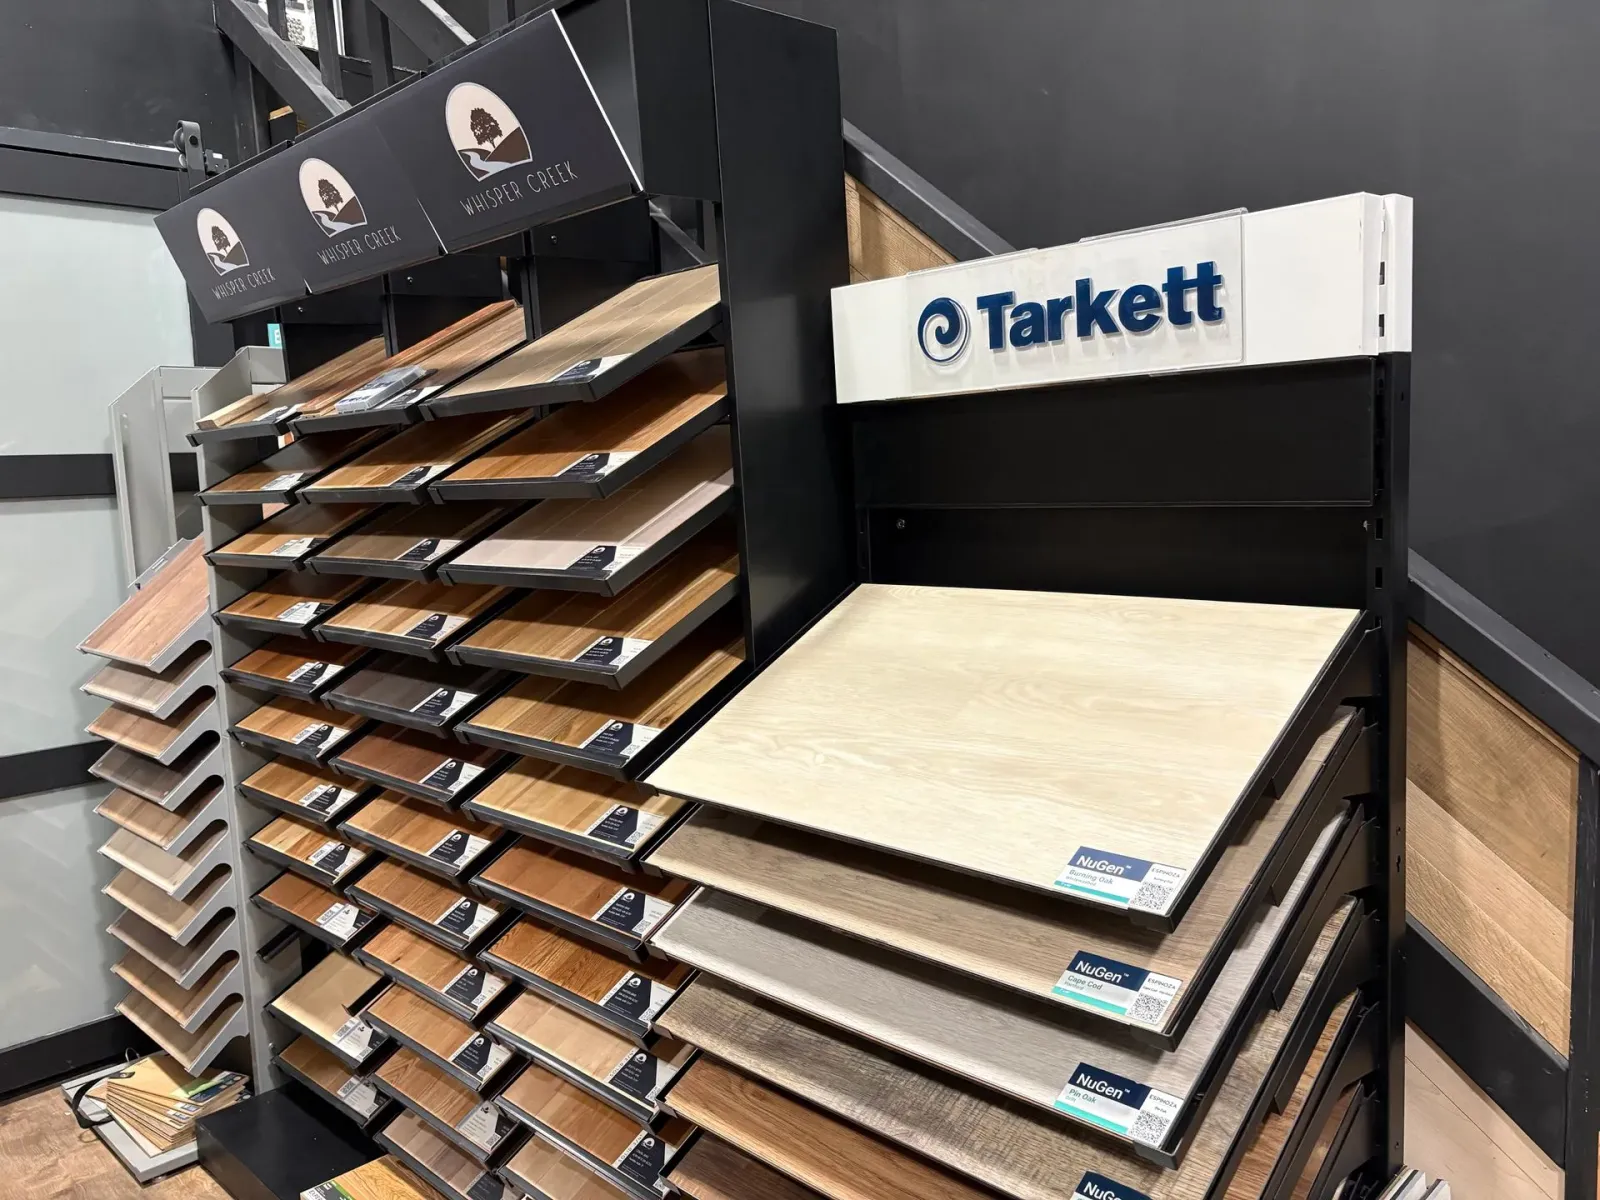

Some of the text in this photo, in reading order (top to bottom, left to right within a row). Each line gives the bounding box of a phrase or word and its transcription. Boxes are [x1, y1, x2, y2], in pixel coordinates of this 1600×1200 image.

[460, 161, 578, 216] WHISPER CREEK
[316, 225, 401, 265] WHISPER CREEK
[211, 267, 276, 300] WHISPER CREEK
[976, 261, 1224, 350] Tarkett
[1069, 869, 1097, 882] Burning
[1098, 873, 1114, 885] Oak
[1067, 975, 1086, 987] Cape
[1088, 979, 1103, 991] Cod
[1068, 1088, 1081, 1098] Pin
[1082, 1093, 1097, 1104] Oak
[1149, 1094, 1177, 1109] ESPINOZA
